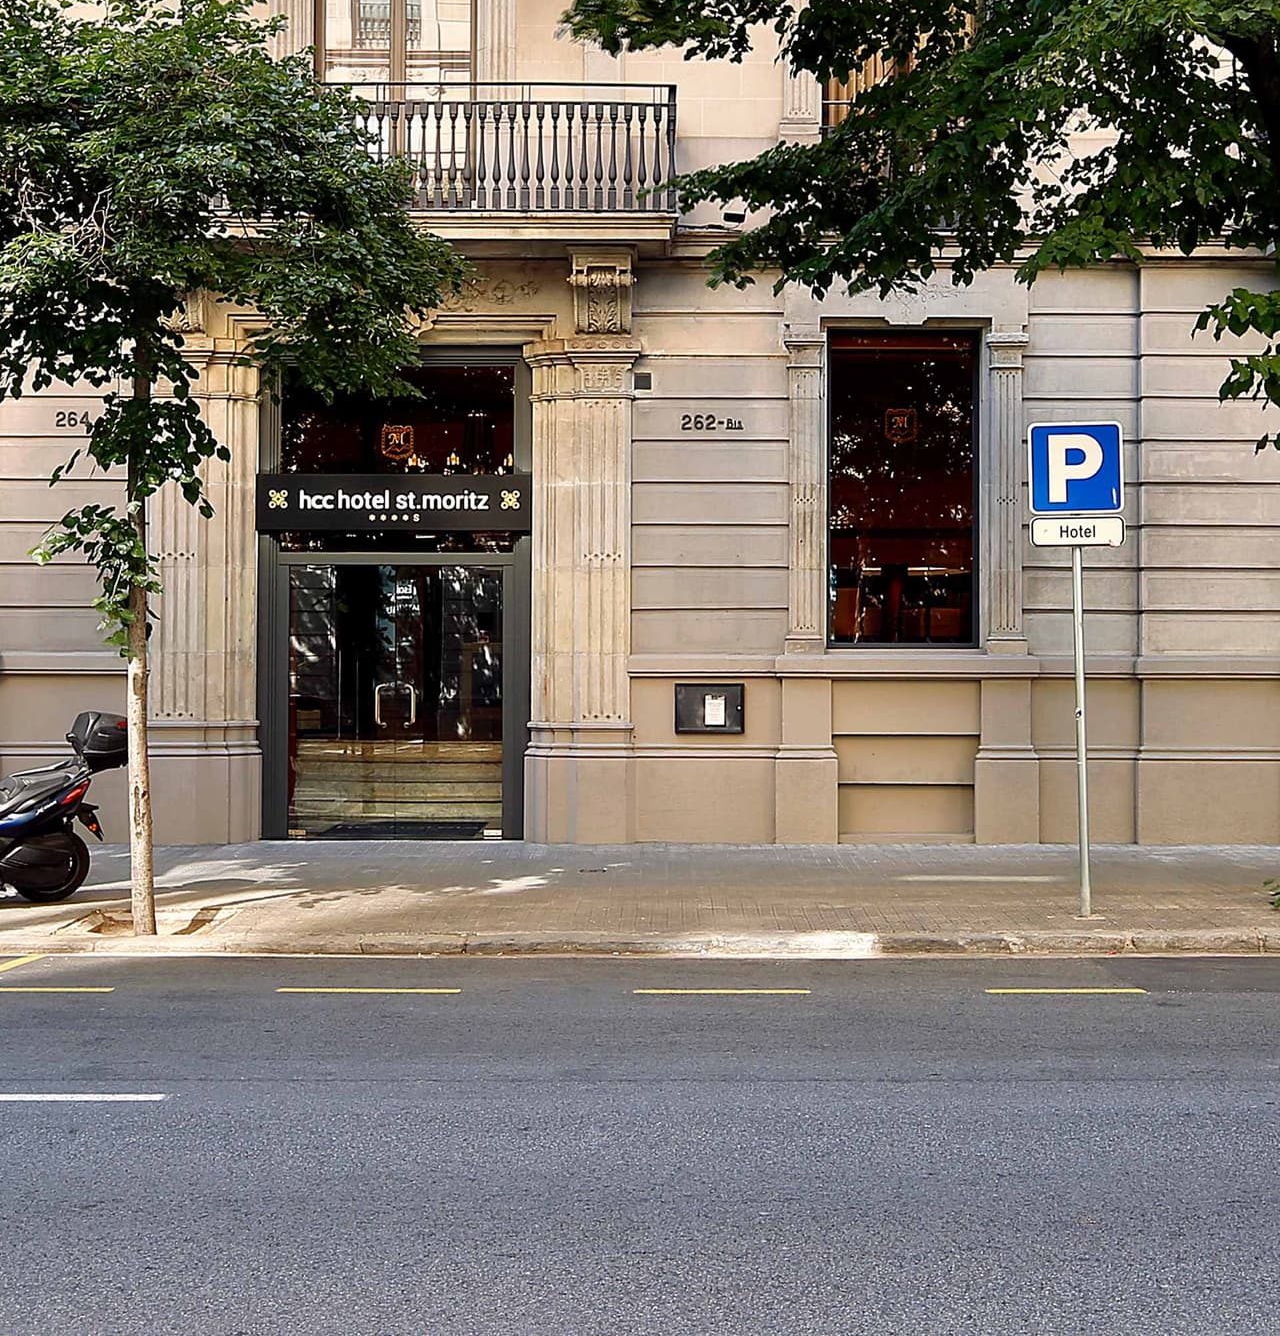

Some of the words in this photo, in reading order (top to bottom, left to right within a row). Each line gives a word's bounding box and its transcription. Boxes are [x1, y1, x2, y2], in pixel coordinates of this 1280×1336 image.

[55, 410, 89, 428] 264
[1047, 433, 1104, 503] P
[299, 488, 335, 510] hcc
[337, 488, 390, 510] hotel
[1060, 525, 1096, 538] Hotel
